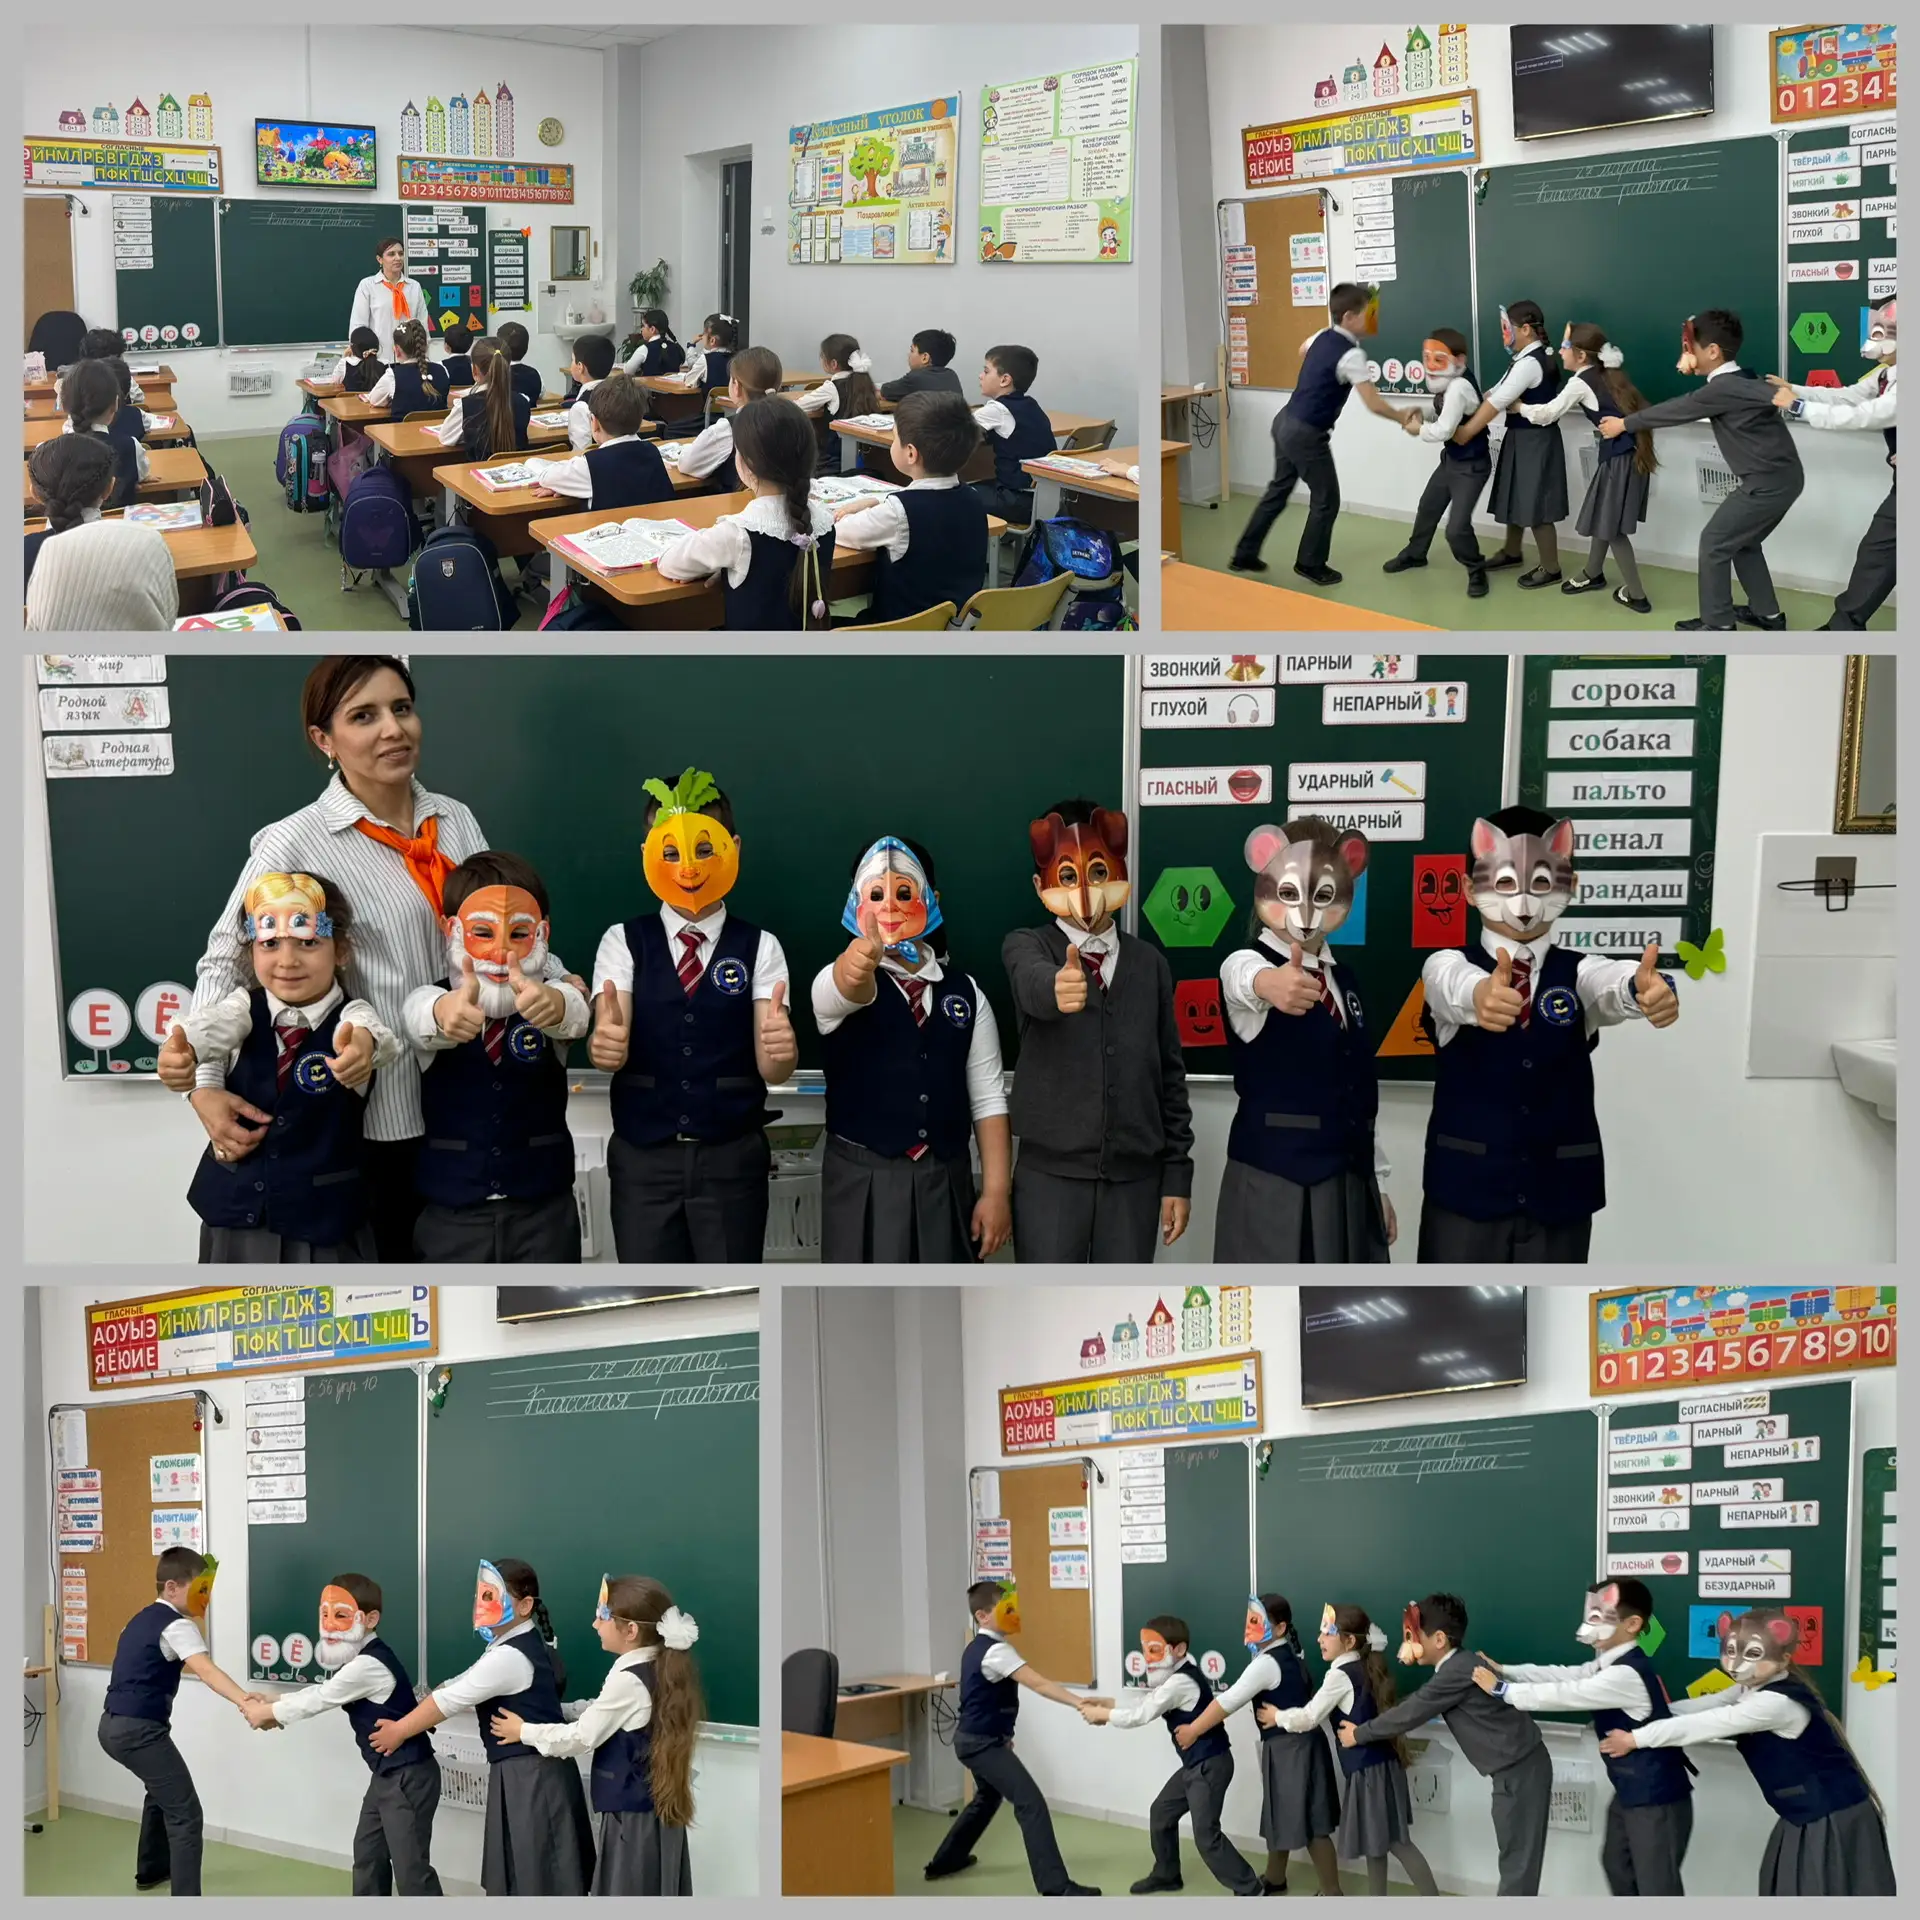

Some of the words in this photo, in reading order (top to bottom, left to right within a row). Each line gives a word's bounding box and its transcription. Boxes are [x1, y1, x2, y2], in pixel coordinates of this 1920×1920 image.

[1779, 90, 1795, 112] 0
[1802, 85, 1814, 107] 1
[1820, 82, 1838, 106] 2
[1843, 80, 1859, 103] 3
[1864, 77, 1883, 100] 4
[878, 107, 925, 128] уголок
[1349, 109, 1392, 122] СОГЛАСНЫЕ
[1793, 152, 1831, 167] ТВЁРДЫЙ
[1792, 175, 1825, 188] МЯГКИЙ
[402, 185, 409, 195] 0
[413, 185, 418, 195] 1
[420, 186, 427, 195] 2
[429, 186, 435, 196] 3
[437, 186, 444, 196] 4
[445, 186, 452, 196] 5
[454, 186, 461, 196] 6
[462, 186, 469, 196] 7
[471, 187, 477, 196] 8
[480, 187, 485, 196] 9
[1791, 207, 1829, 219] ЗВОНКИЙ
[1792, 227, 1823, 238] ГЛУХОЙ
[1791, 266, 1829, 278] ГЛАСНЫЙ
[125, 331, 133, 340] Е
[145, 327, 152, 340] Ё
[164, 330, 175, 339] Ю
[186, 327, 195, 337] Я
[1388, 363, 1396, 380] Ё
[1409, 365, 1422, 379] Ю
[98, 661, 124, 673] мир
[1150, 658, 1221, 677] ЗВОНКИЙ
[58, 695, 106, 708] Родной
[1333, 690, 1422, 713] НЕПАРНЫЙ
[1571, 682, 1676, 706] сорока
[1151, 697, 1208, 716] ГЛУХОЙ
[66, 711, 101, 720] язык
[1569, 727, 1672, 752] собака
[101, 742, 150, 754] Родная
[88, 757, 170, 771] литература
[1147, 776, 1218, 796] ГЛАСНЫЙ
[1298, 769, 1374, 791] УДАРНЫЙ
[1572, 783, 1666, 801] пальто
[1298, 809, 1402, 830] УДАРНЫЙ
[1574, 831, 1664, 851] пенал
[1573, 882, 1683, 903] рандаш
[1554, 929, 1663, 949] лисица
[88, 1004, 112, 1036] Е
[155, 992, 180, 1035] Ё
[104, 1306, 144, 1320] ГЛАСНЫЕ
[411, 1312, 429, 1336] Ъ
[1600, 1359, 1617, 1384] 0
[1627, 1356, 1638, 1381] 1
[1647, 1353, 1665, 1379] 2
[1671, 1349, 1690, 1376] 3
[1694, 1345, 1716, 1373] 4
[1722, 1342, 1741, 1370] 5
[1748, 1339, 1770, 1367] 6
[1776, 1335, 1798, 1364] 7
[1802, 1331, 1827, 1361] 8
[1834, 1327, 1858, 1358] 9
[1862, 1323, 1890, 1354] 10
[588, 1362, 616, 1380] 27
[362, 1375, 378, 1391] 10
[524, 1384, 632, 1416] Классная
[1681, 1399, 1743, 1416] СОГЛАСНЫЙ
[1614, 1430, 1658, 1445] ТВЁРДЫЙ
[1698, 1424, 1742, 1439] ПАРНЫЙ
[1730, 1444, 1790, 1460] НЕПАРНЫЙ
[154, 1458, 196, 1469] СЛОЖЕНИЕ
[1613, 1455, 1651, 1469] МЯГКИЙ
[1612, 1490, 1655, 1504] ЗВОНКИЙ
[1696, 1485, 1739, 1498] ПАРНЫЙ
[153, 1512, 199, 1523] ВЫЧИТАНИ
[1613, 1513, 1648, 1526] ГЛУХОЙ
[1727, 1507, 1788, 1521] НЕПАРНЫЙ
[1611, 1556, 1655, 1570] ГЛАСНЫЙ
[1705, 1554, 1756, 1568] УДАРНЫЙ
[1704, 1577, 1776, 1591] БЕЗУДАРНЫЙ
[260, 1642, 271, 1660] Е
[290, 1639, 303, 1662] Ё
[1132, 1656, 1141, 1671] Е
[1207, 1657, 1219, 1672] Я
